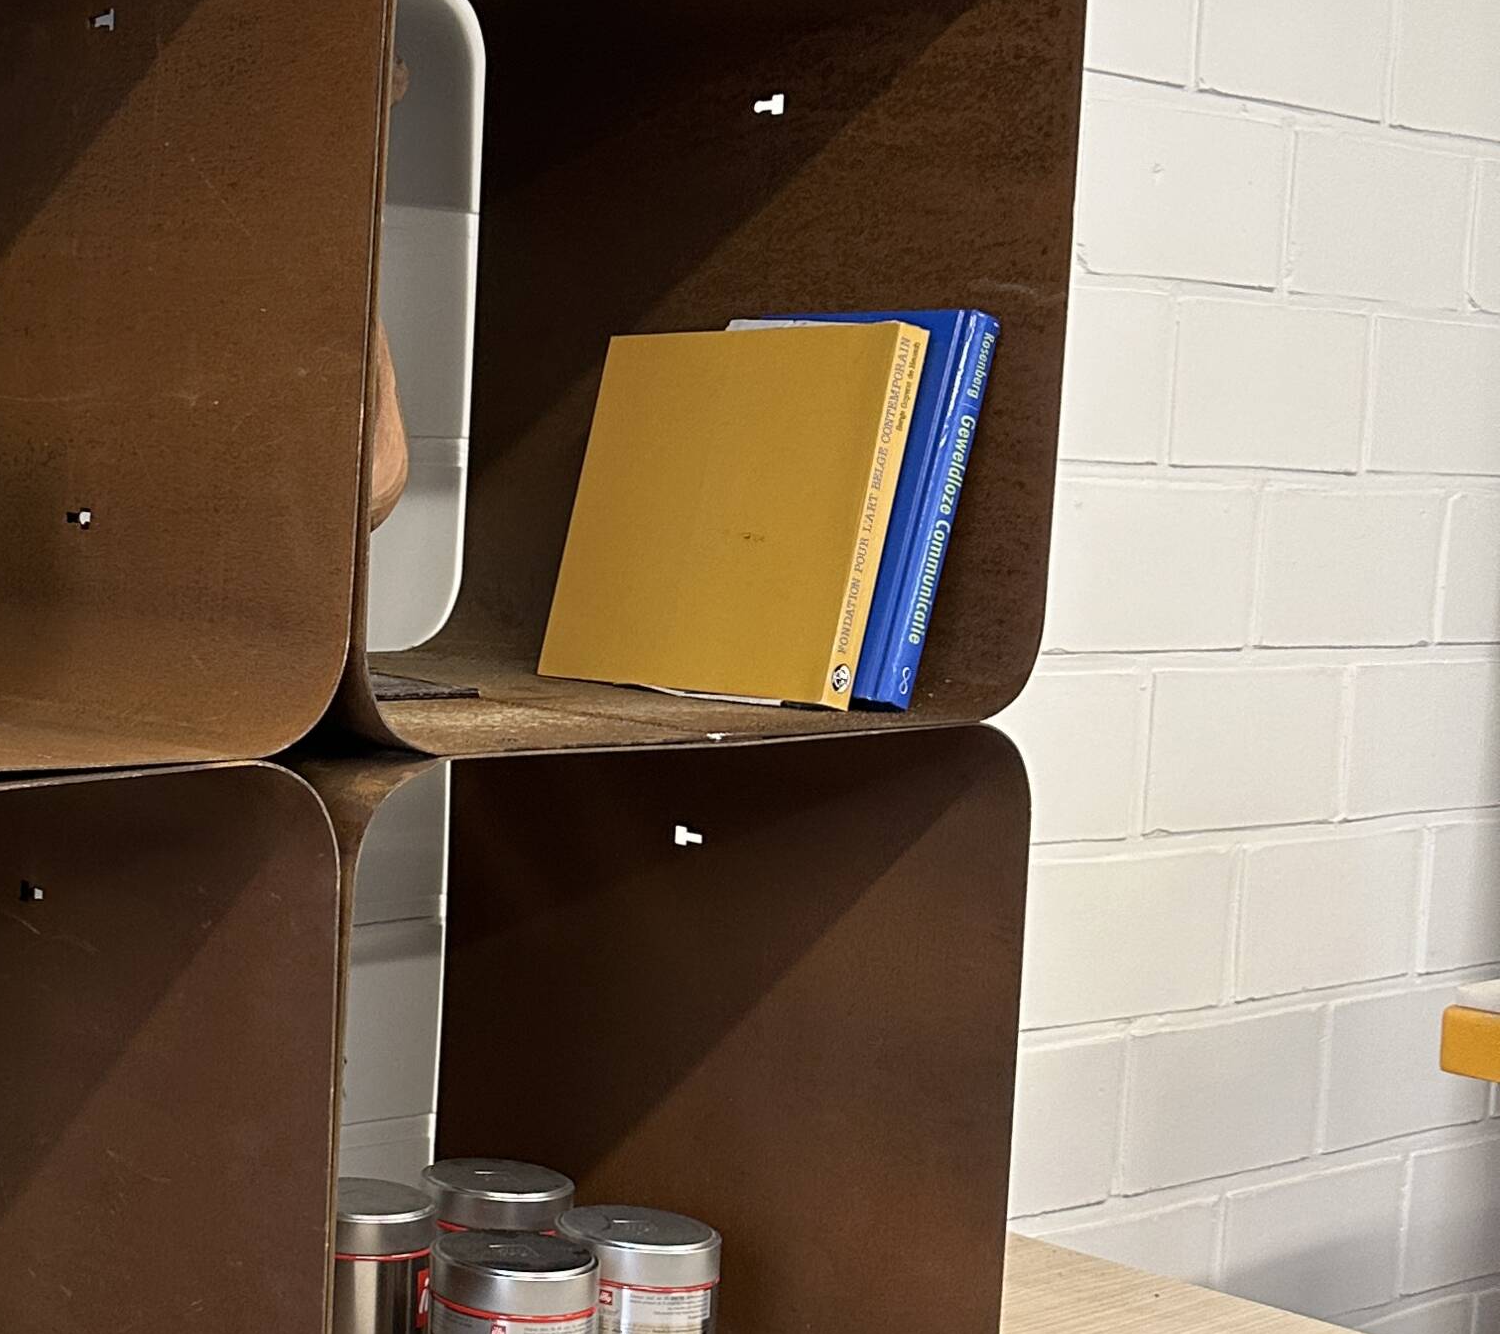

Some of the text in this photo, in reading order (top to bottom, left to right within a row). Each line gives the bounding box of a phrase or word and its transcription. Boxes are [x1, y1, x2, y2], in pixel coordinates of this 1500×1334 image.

[837, 336, 911, 654] FONDATION POUR L'ART BELGE CONTEMPORAIN
[908, 331, 995, 645] Rosenberg Geweldloze Communicatie
